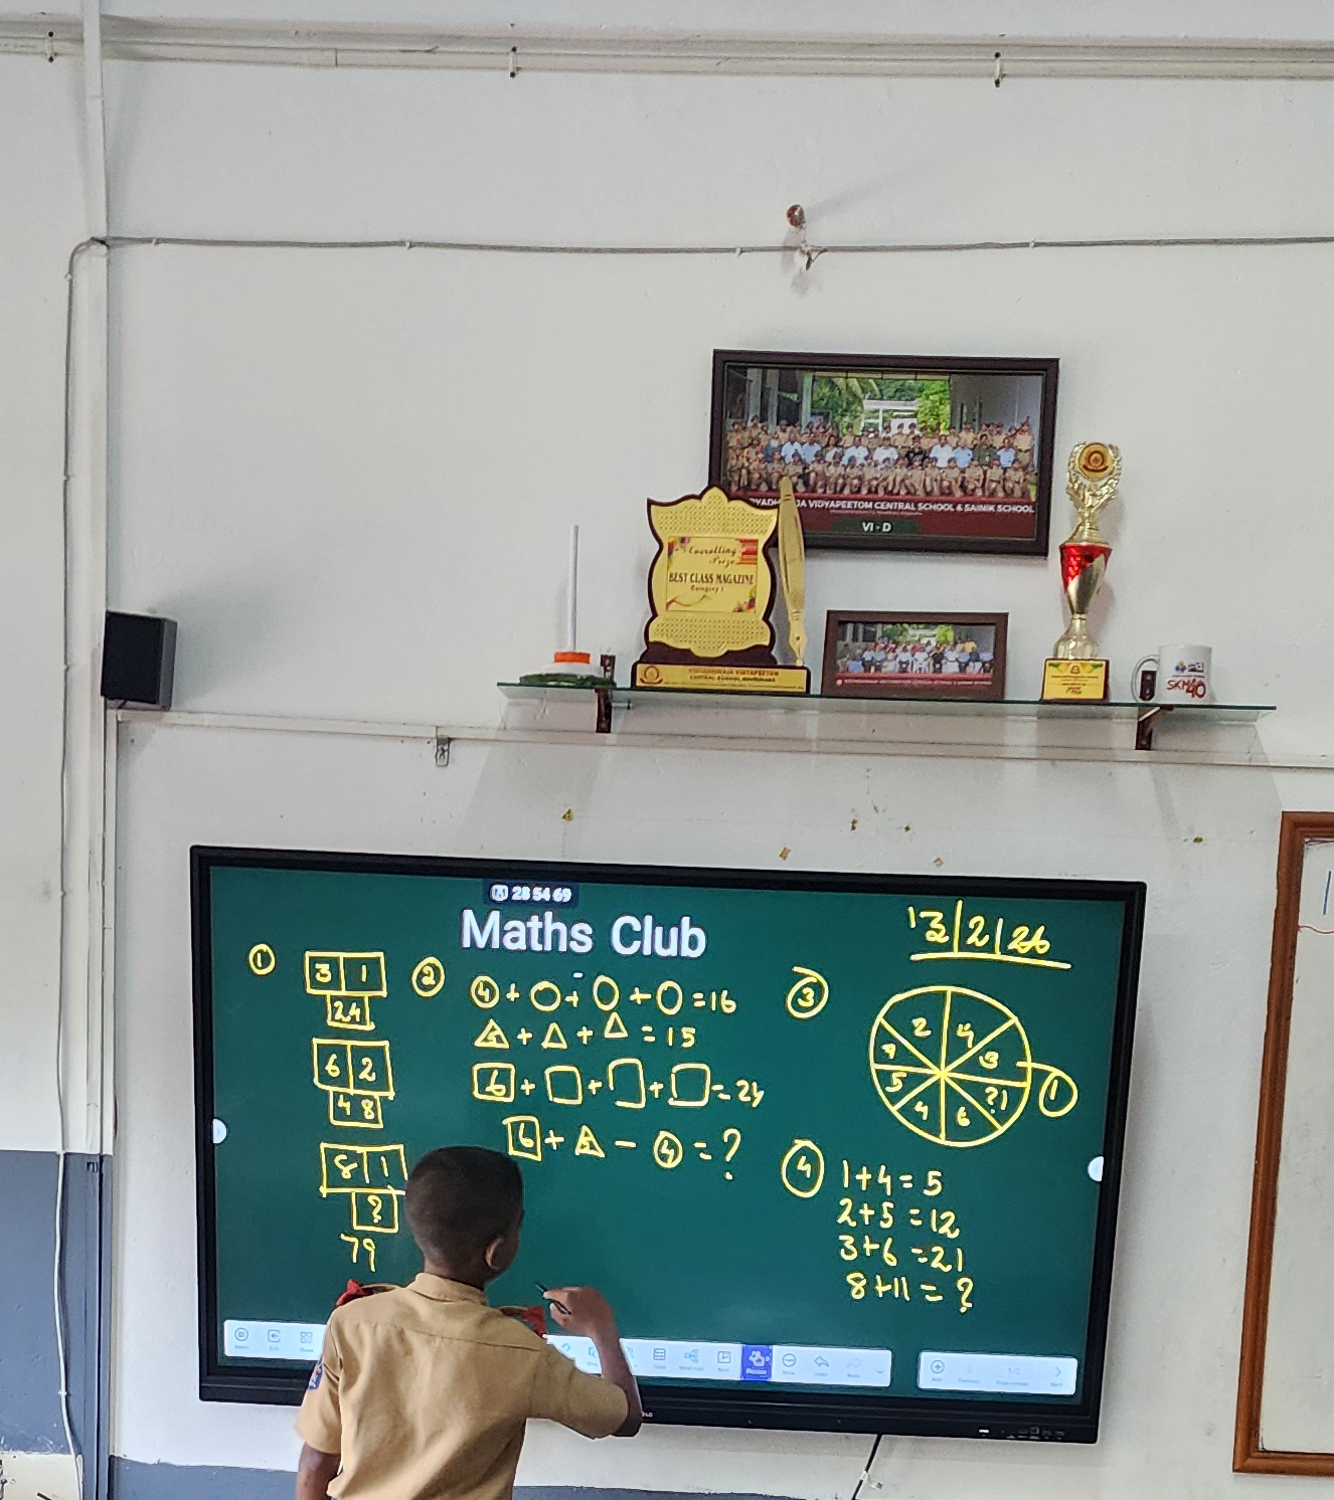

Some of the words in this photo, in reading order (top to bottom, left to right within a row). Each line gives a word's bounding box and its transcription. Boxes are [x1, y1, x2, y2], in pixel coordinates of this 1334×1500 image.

[809, 500, 873, 509] VIDYAPEETOM
[874, 501, 916, 511] CENTRAL
[918, 502, 955, 511] SCHOOL
[956, 504, 963, 512] &
[964, 504, 995, 512] SAINIK
[997, 505, 1035, 514] SCHOOL
[862, 521, 874, 532] VI
[881, 522, 892, 532] D
[669, 572, 687, 583] BEST
[689, 572, 714, 583] CLASS
[716, 573, 754, 585] MAGAZINE
[461, 908, 593, 953] Maths
[611, 915, 707, 958] Club
[911, 1017, 932, 1038] 2
[324, 1053, 341, 1078] 6
[358, 1057, 376, 1082] 2
[723, 1128, 741, 1180] ?
